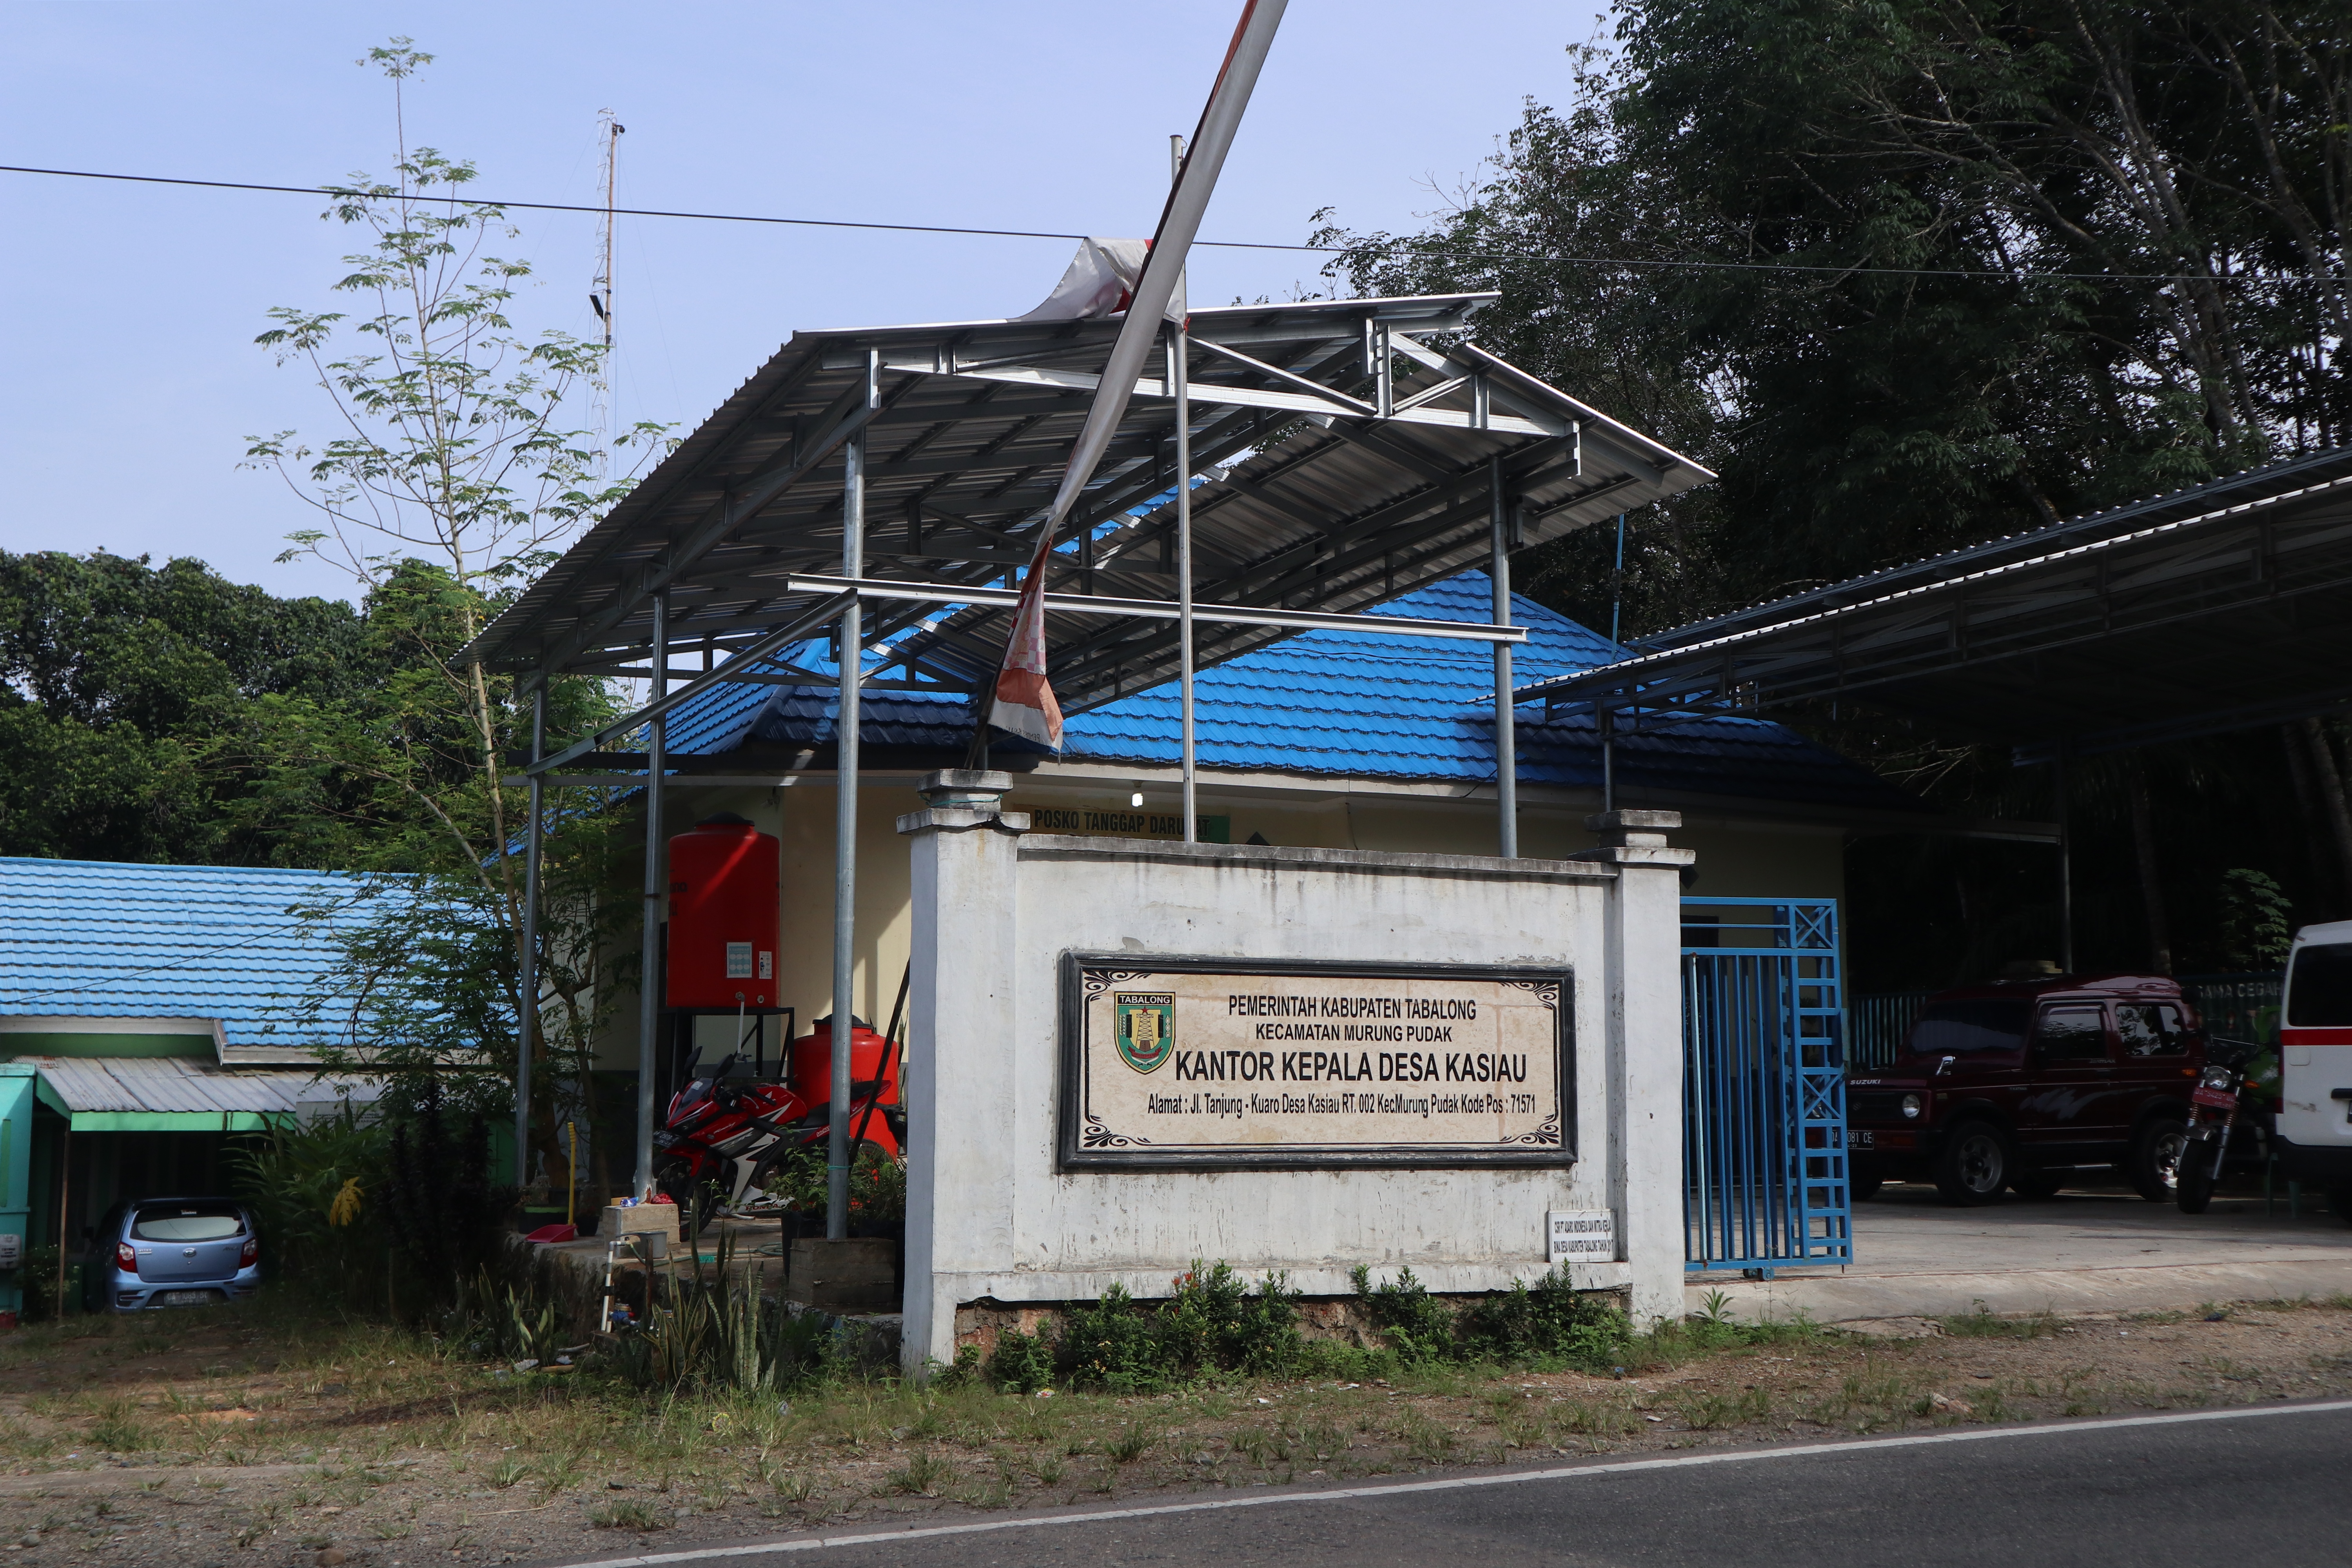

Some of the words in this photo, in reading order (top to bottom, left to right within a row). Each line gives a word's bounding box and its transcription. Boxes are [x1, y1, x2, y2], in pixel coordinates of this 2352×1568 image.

[1034, 809, 1079, 830] POSKO
[1084, 811, 1145, 833] TANGGAP
[1150, 816, 1210, 837] DARUAT
[2237, 982, 2283, 997] CEGAH
[1229, 995, 1316, 1017] PEMERINTAH
[1321, 997, 1401, 1018] KABUPATEN
[1405, 998, 1476, 1020] TABALONG
[1256, 1024, 1339, 1041] KECAMATAN
[1345, 1025, 1403, 1042] MURUNG
[1407, 1026, 1452, 1042] PUDAK
[1176, 1051, 1275, 1081] KANTOR
[1282, 1052, 1373, 1081] KEPALA
[1379, 1052, 1439, 1082] DESA
[1446, 1053, 1526, 1083] KASIAU
[1148, 1093, 1182, 1114] Alamat
[1204, 1093, 1242, 1119] Tanjung
[1251, 1093, 1279, 1114] Kuaro
[1282, 1093, 1305, 1114] Desa
[1308, 1093, 1339, 1114] Kasiau
[1342, 1093, 1356, 1113] RT.
[1359, 1093, 1375, 1113] 002
[1431, 1094, 1459, 1113] Pudak
[1461, 1094, 1484, 1114] Kode
[1486, 1093, 1503, 1114] Pos
[1511, 1094, 1535, 1113] 71571
[1847, 1132, 1859, 1143] 081
[1864, 1132, 1872, 1143] CE
